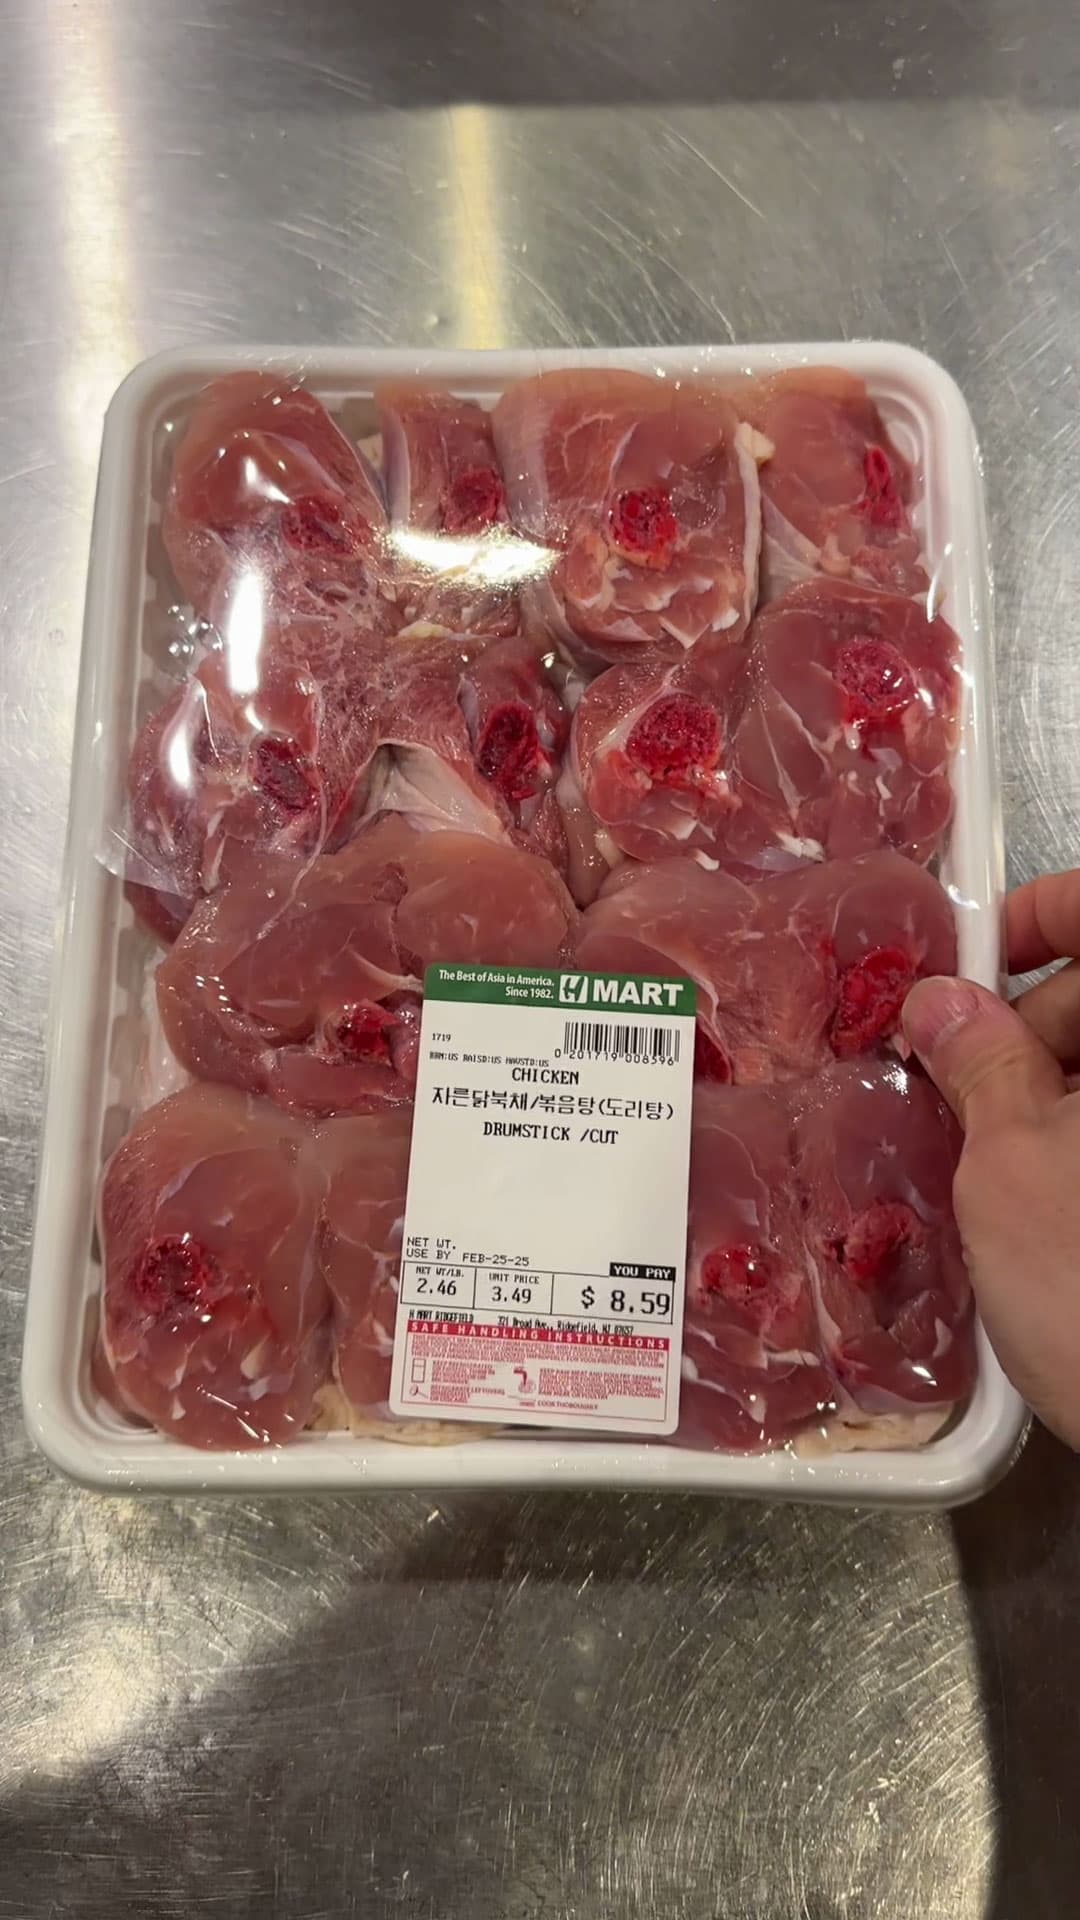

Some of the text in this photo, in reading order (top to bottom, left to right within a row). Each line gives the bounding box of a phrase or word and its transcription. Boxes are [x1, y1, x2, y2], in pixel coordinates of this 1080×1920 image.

[439, 969, 555, 986] The Best of Asia in America.
[505, 986, 554, 999] Since 1982.
[593, 979, 684, 1007] MART
[432, 1032, 451, 1042] 1719
[554, 1048, 674, 1066] 0 201719 008596
[512, 1067, 579, 1085] CHICKEN
[483, 1121, 618, 1144] DRUMSTICK /CUT
[407, 1236, 456, 1250] NET WT.
[406, 1248, 529, 1266] USE BY FEB-25-25
[416, 1266, 431, 1276] NET
[489, 1273, 540, 1285] UNIT PRICE
[614, 1265, 671, 1279] YOU PAY
[417, 1277, 457, 1296] 2.46
[491, 1285, 532, 1304] 3.49
[581, 1284, 670, 1315] $ 8.59
[411, 1321, 665, 1347] SAFE HANDLING INSTRUCTIONS
